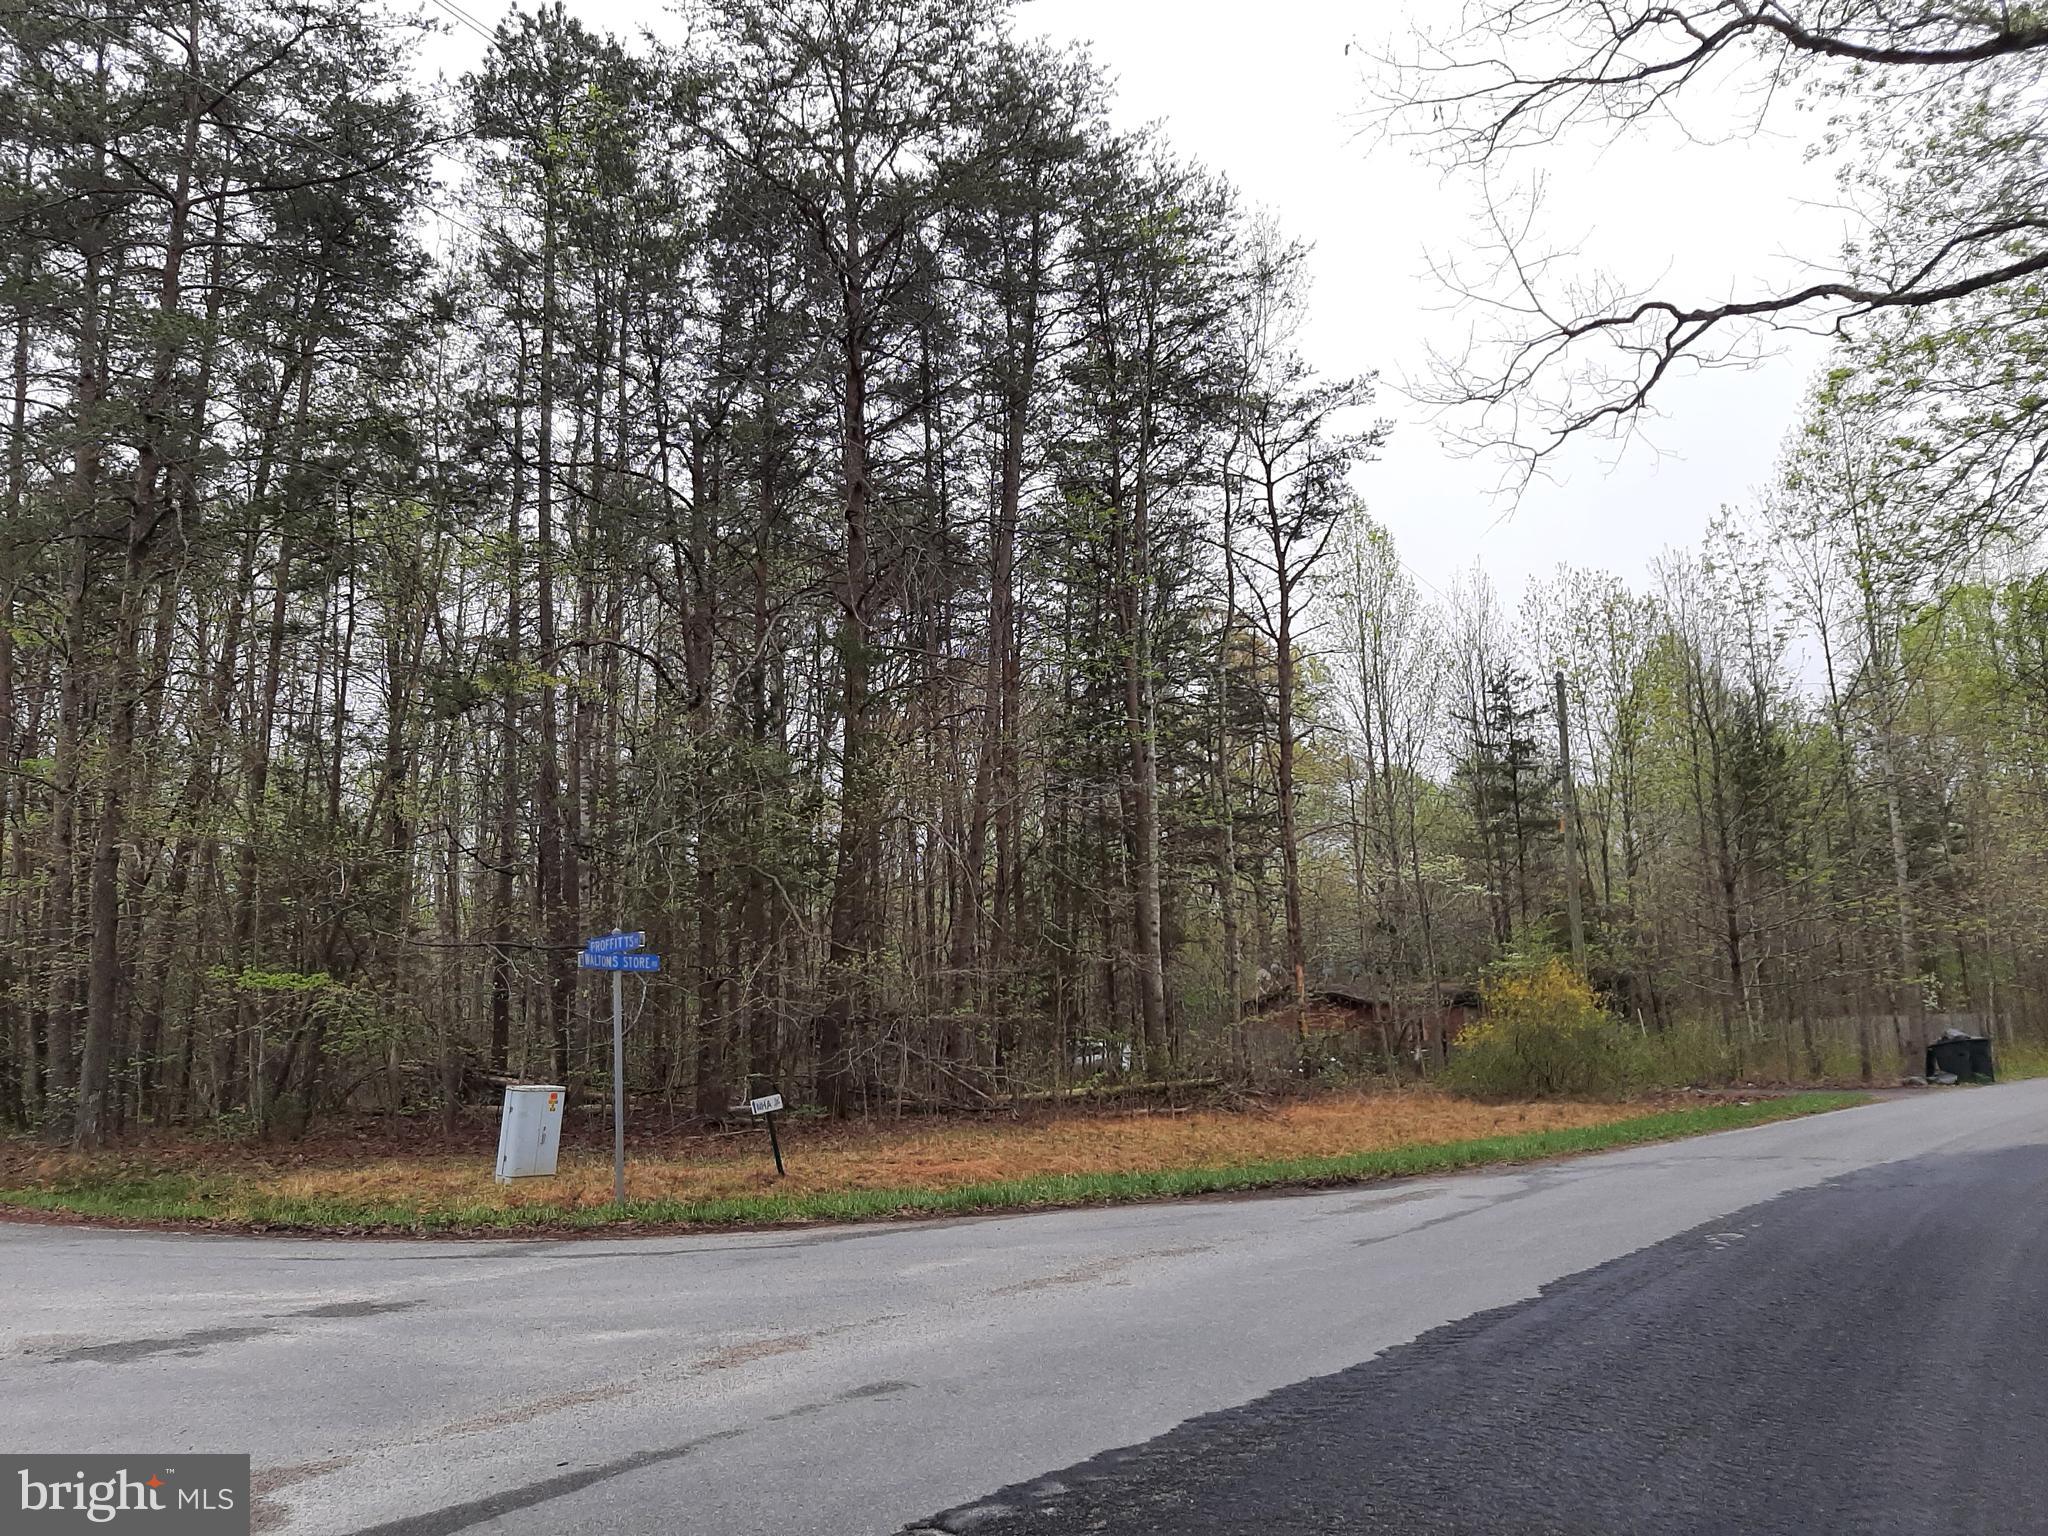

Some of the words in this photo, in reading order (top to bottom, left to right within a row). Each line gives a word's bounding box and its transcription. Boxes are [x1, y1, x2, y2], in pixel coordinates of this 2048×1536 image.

[590, 936, 634, 953] PROFFITTS
[584, 953, 619, 968] WALTONS
[623, 956, 651, 969] STORE
